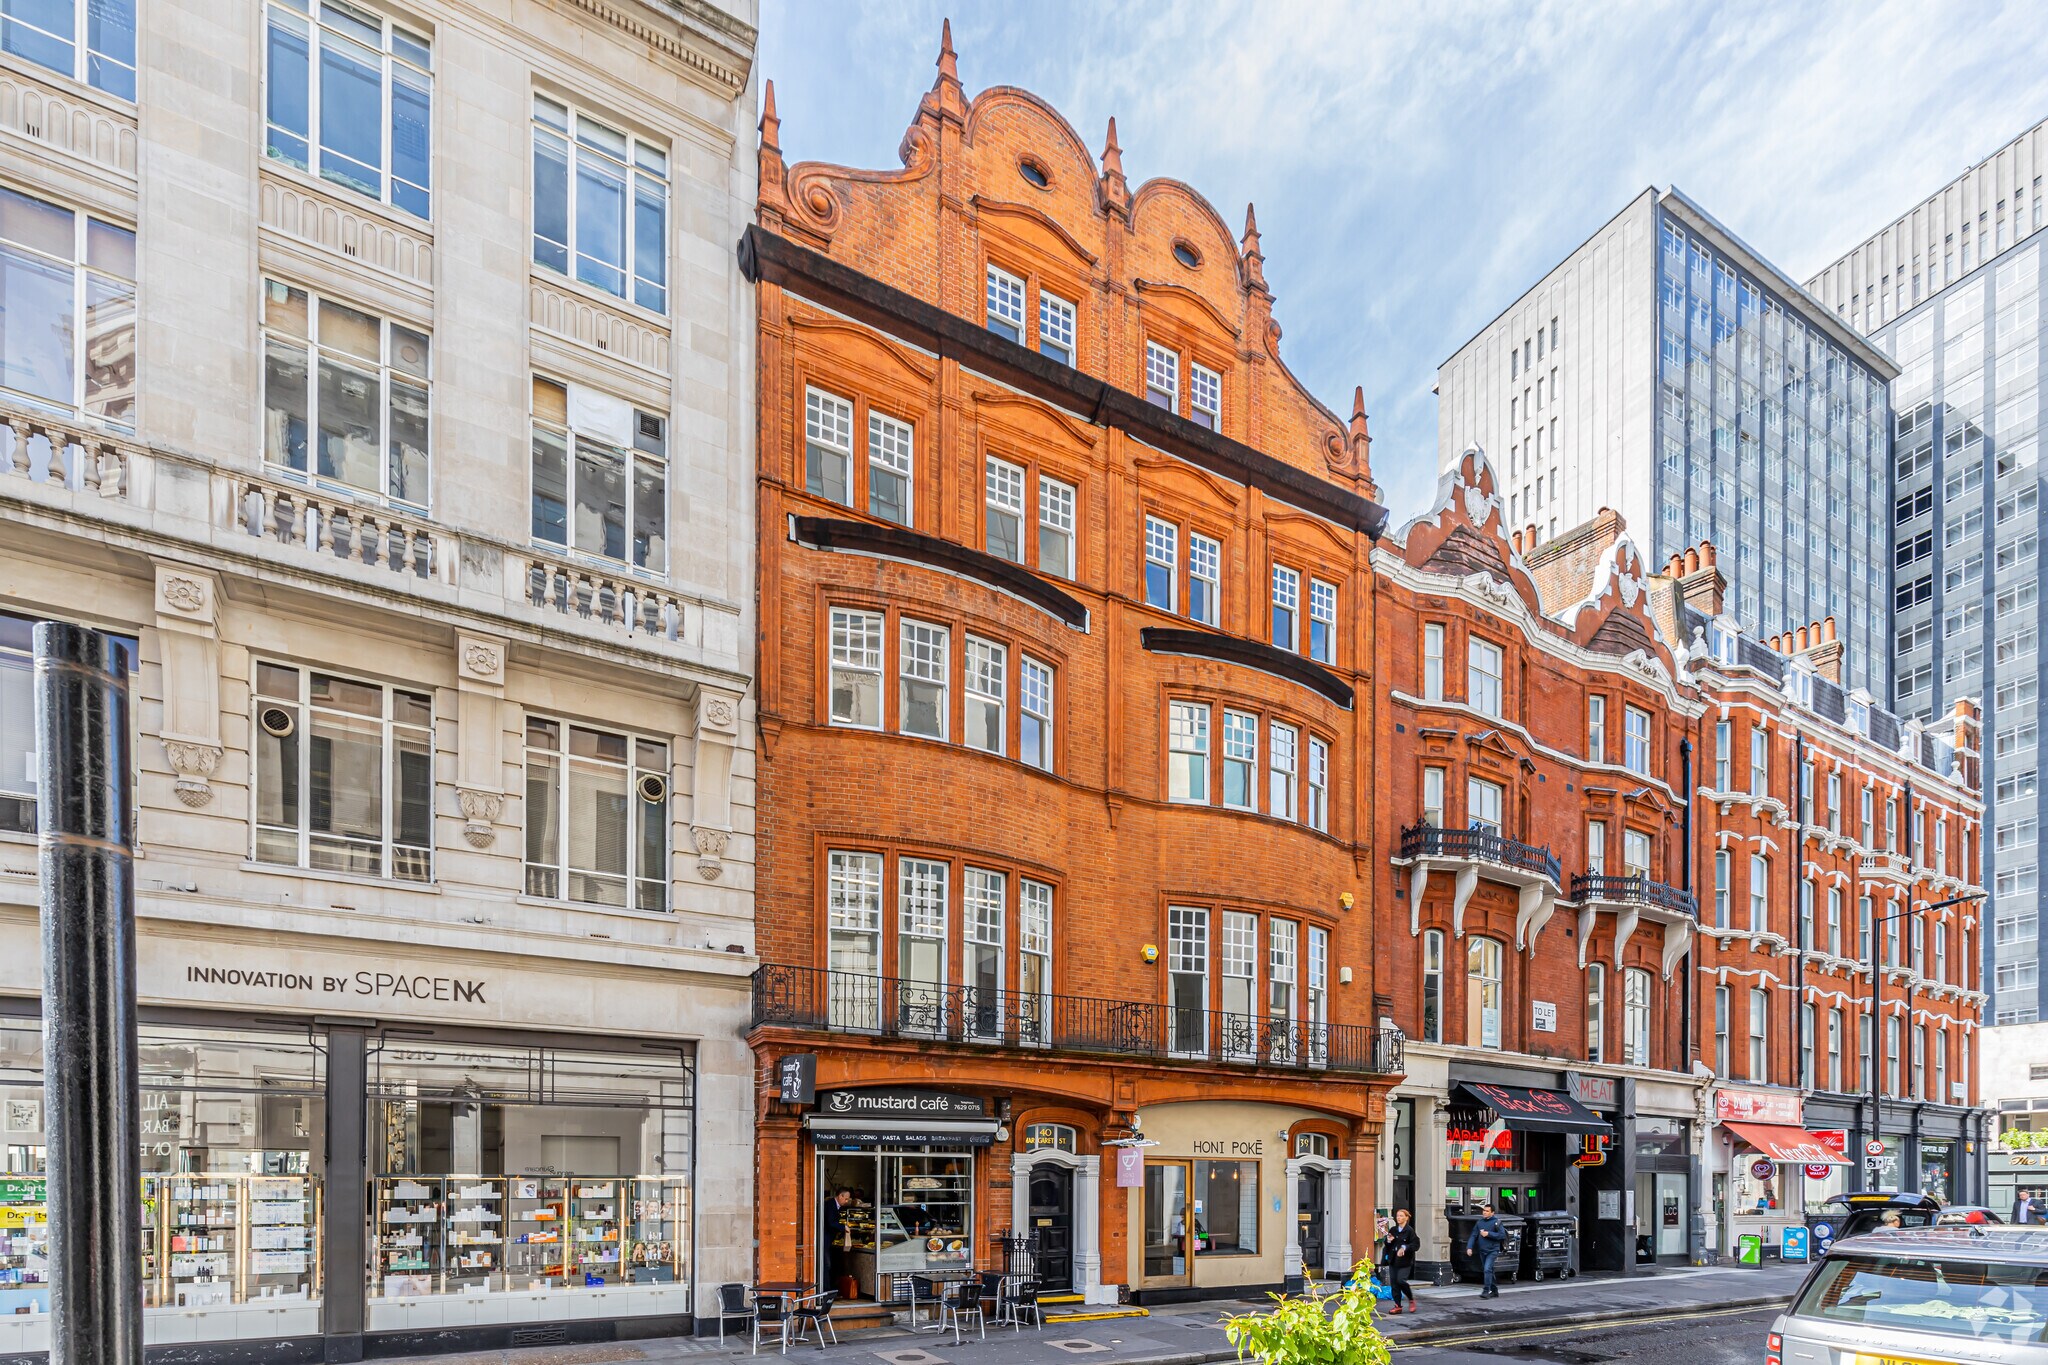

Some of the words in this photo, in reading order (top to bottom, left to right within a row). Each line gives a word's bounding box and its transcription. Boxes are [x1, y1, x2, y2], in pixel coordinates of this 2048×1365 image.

[187, 966, 313, 990] INNOVATION
[323, 976, 348, 993] BY
[1535, 1007, 1543, 1016] TO
[1544, 1009, 1555, 1018] LET
[1580, 1079, 1614, 1100] MEAT
[858, 1095, 917, 1110] mustard
[920, 1096, 949, 1111] café
[1039, 1128, 1052, 1137] 40
[1300, 1138, 1310, 1148] 39
[1820, 1136, 1844, 1147] Wine
[1193, 1140, 1225, 1154] HONI
[1231, 1140, 1263, 1155] POKĒ
[1869, 1144, 1882, 1152] 20
[1938, 1146, 1949, 1154] GOLF
[2010, 1155, 2037, 1166] The
[1664, 1207, 1678, 1216] LCC
